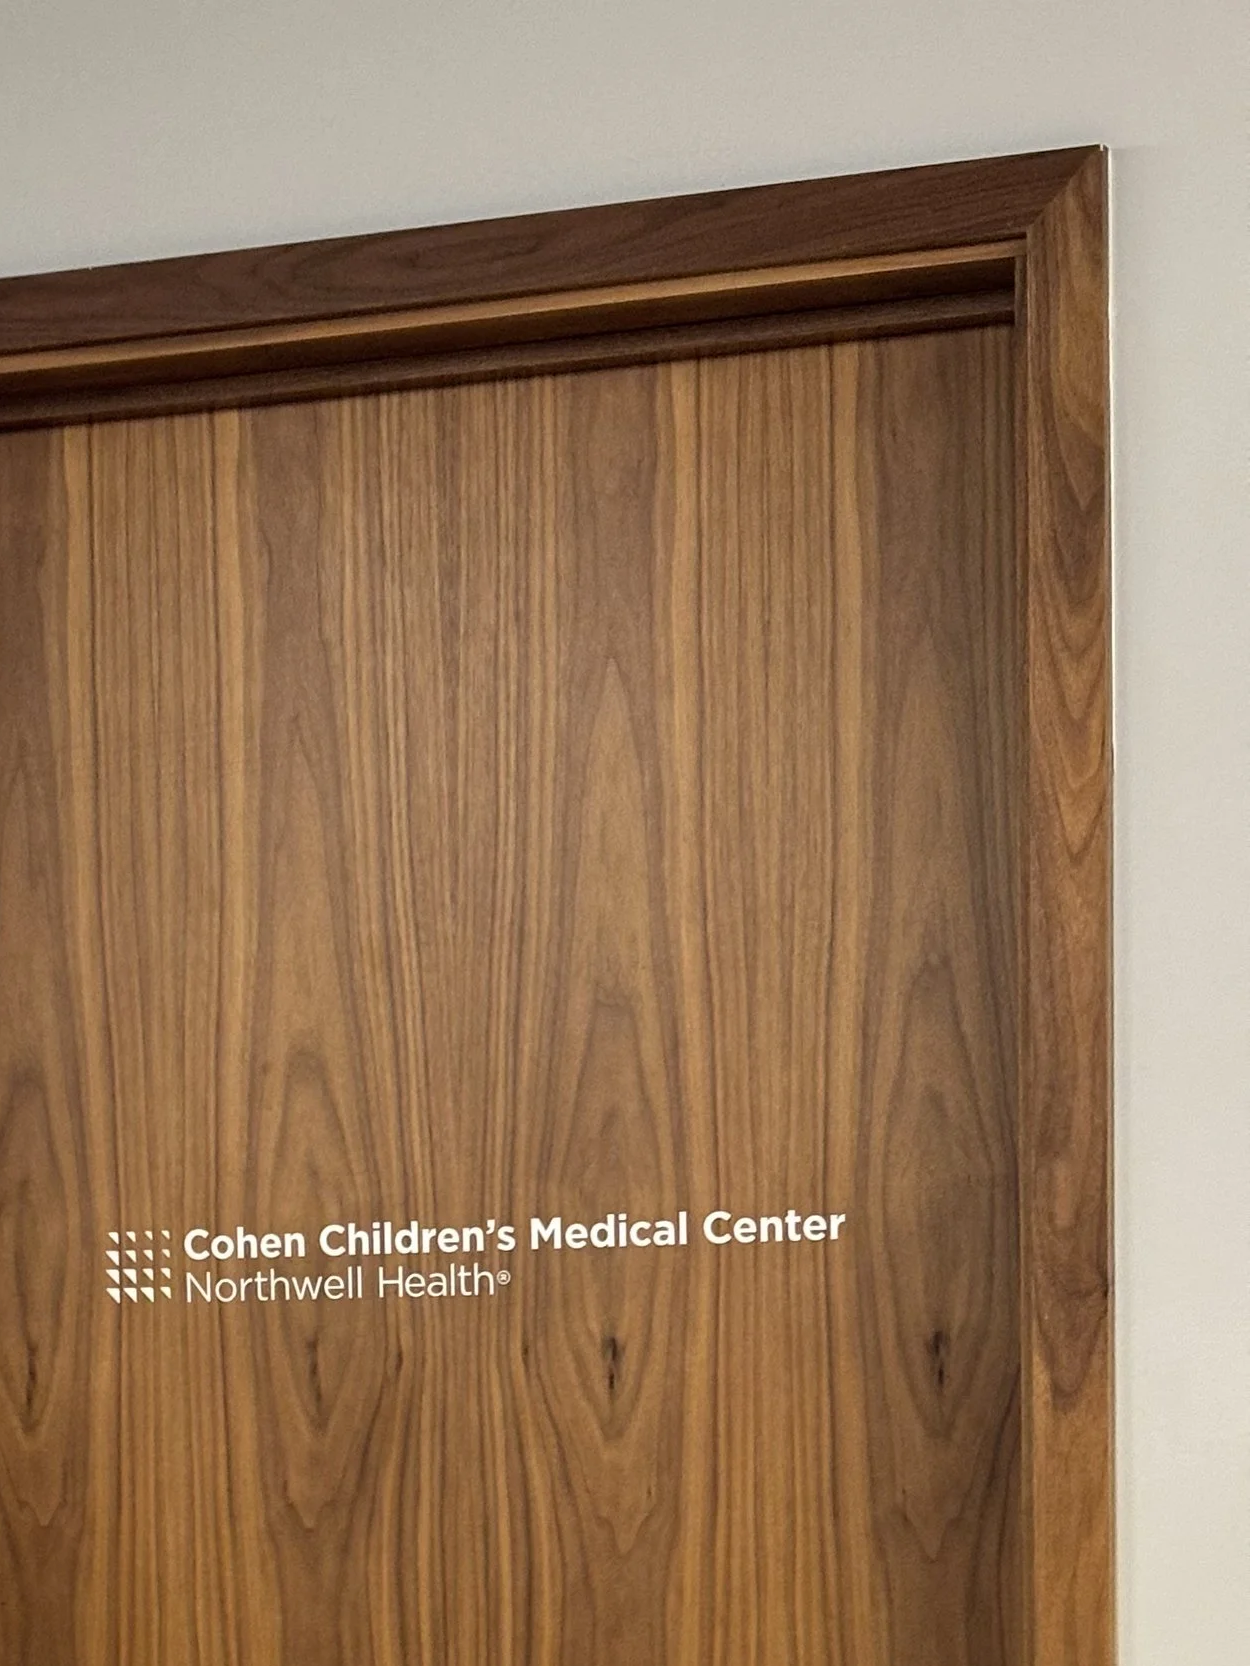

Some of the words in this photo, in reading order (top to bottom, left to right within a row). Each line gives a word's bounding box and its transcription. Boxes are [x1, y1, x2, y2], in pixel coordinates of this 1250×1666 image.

[183, 1226, 306, 1260] Cohen
[319, 1219, 517, 1257] Children's
[530, 1211, 688, 1250] Medical
[703, 1209, 846, 1245] Center
[186, 1266, 363, 1303] Northwell
